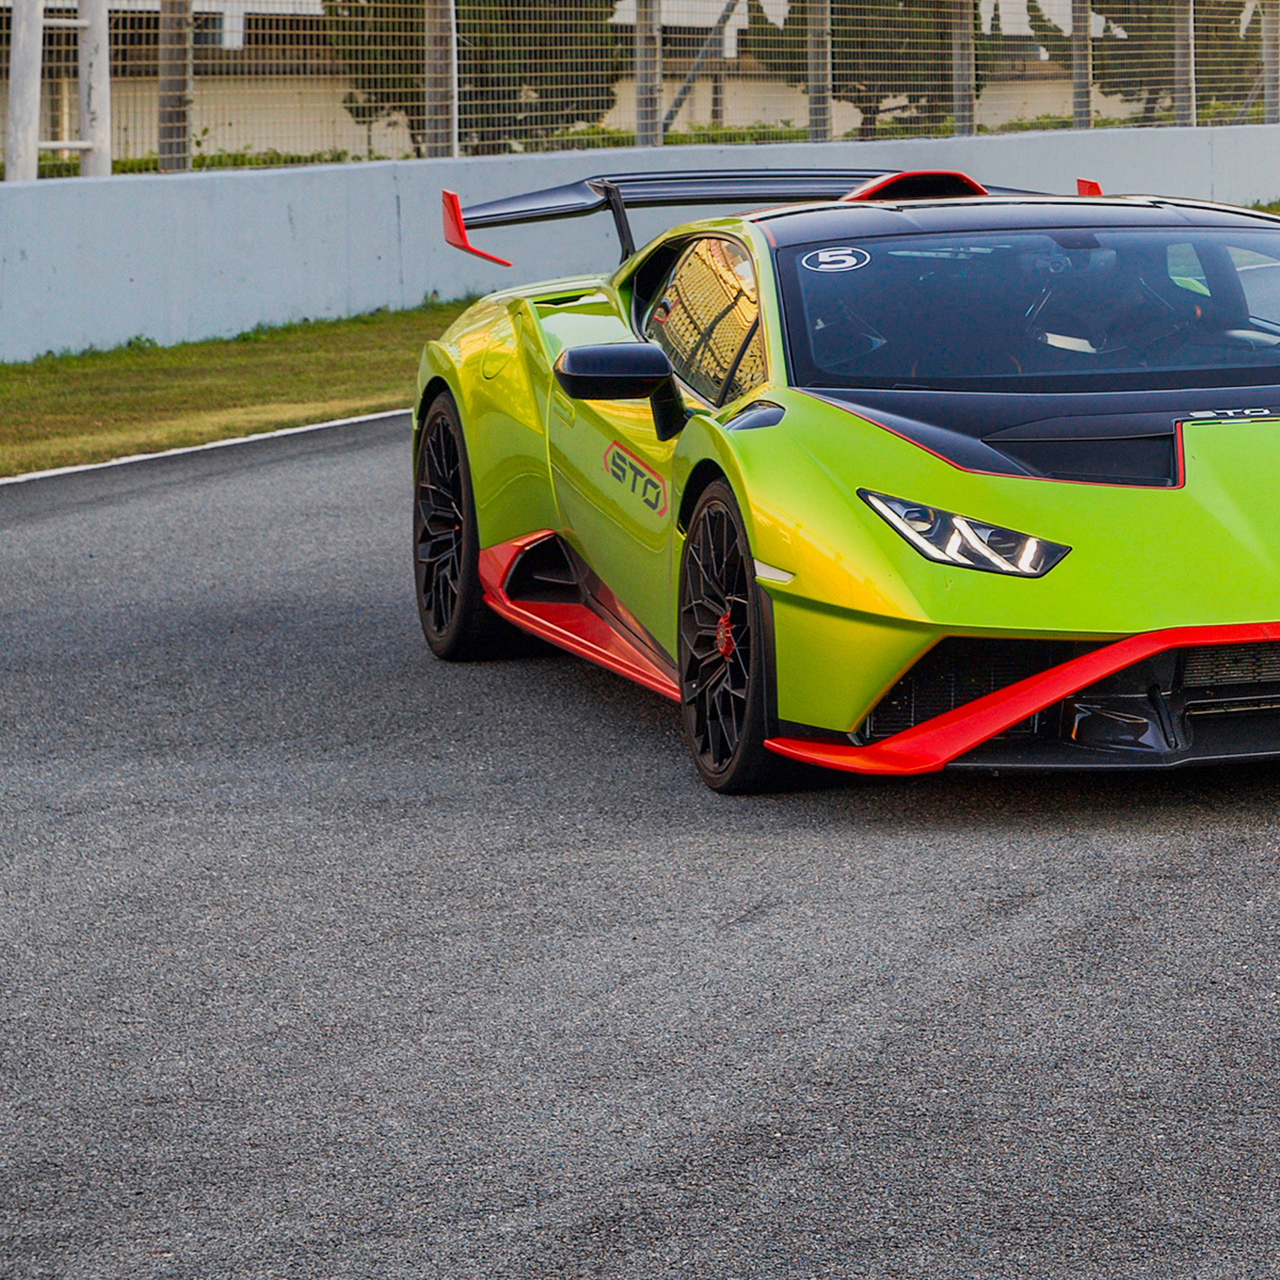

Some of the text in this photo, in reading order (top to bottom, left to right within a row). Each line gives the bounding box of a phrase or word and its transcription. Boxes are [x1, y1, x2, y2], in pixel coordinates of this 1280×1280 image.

[818, 249, 857, 269] 5
[1189, 408, 1271, 418] STO
[610, 450, 661, 511] STO
